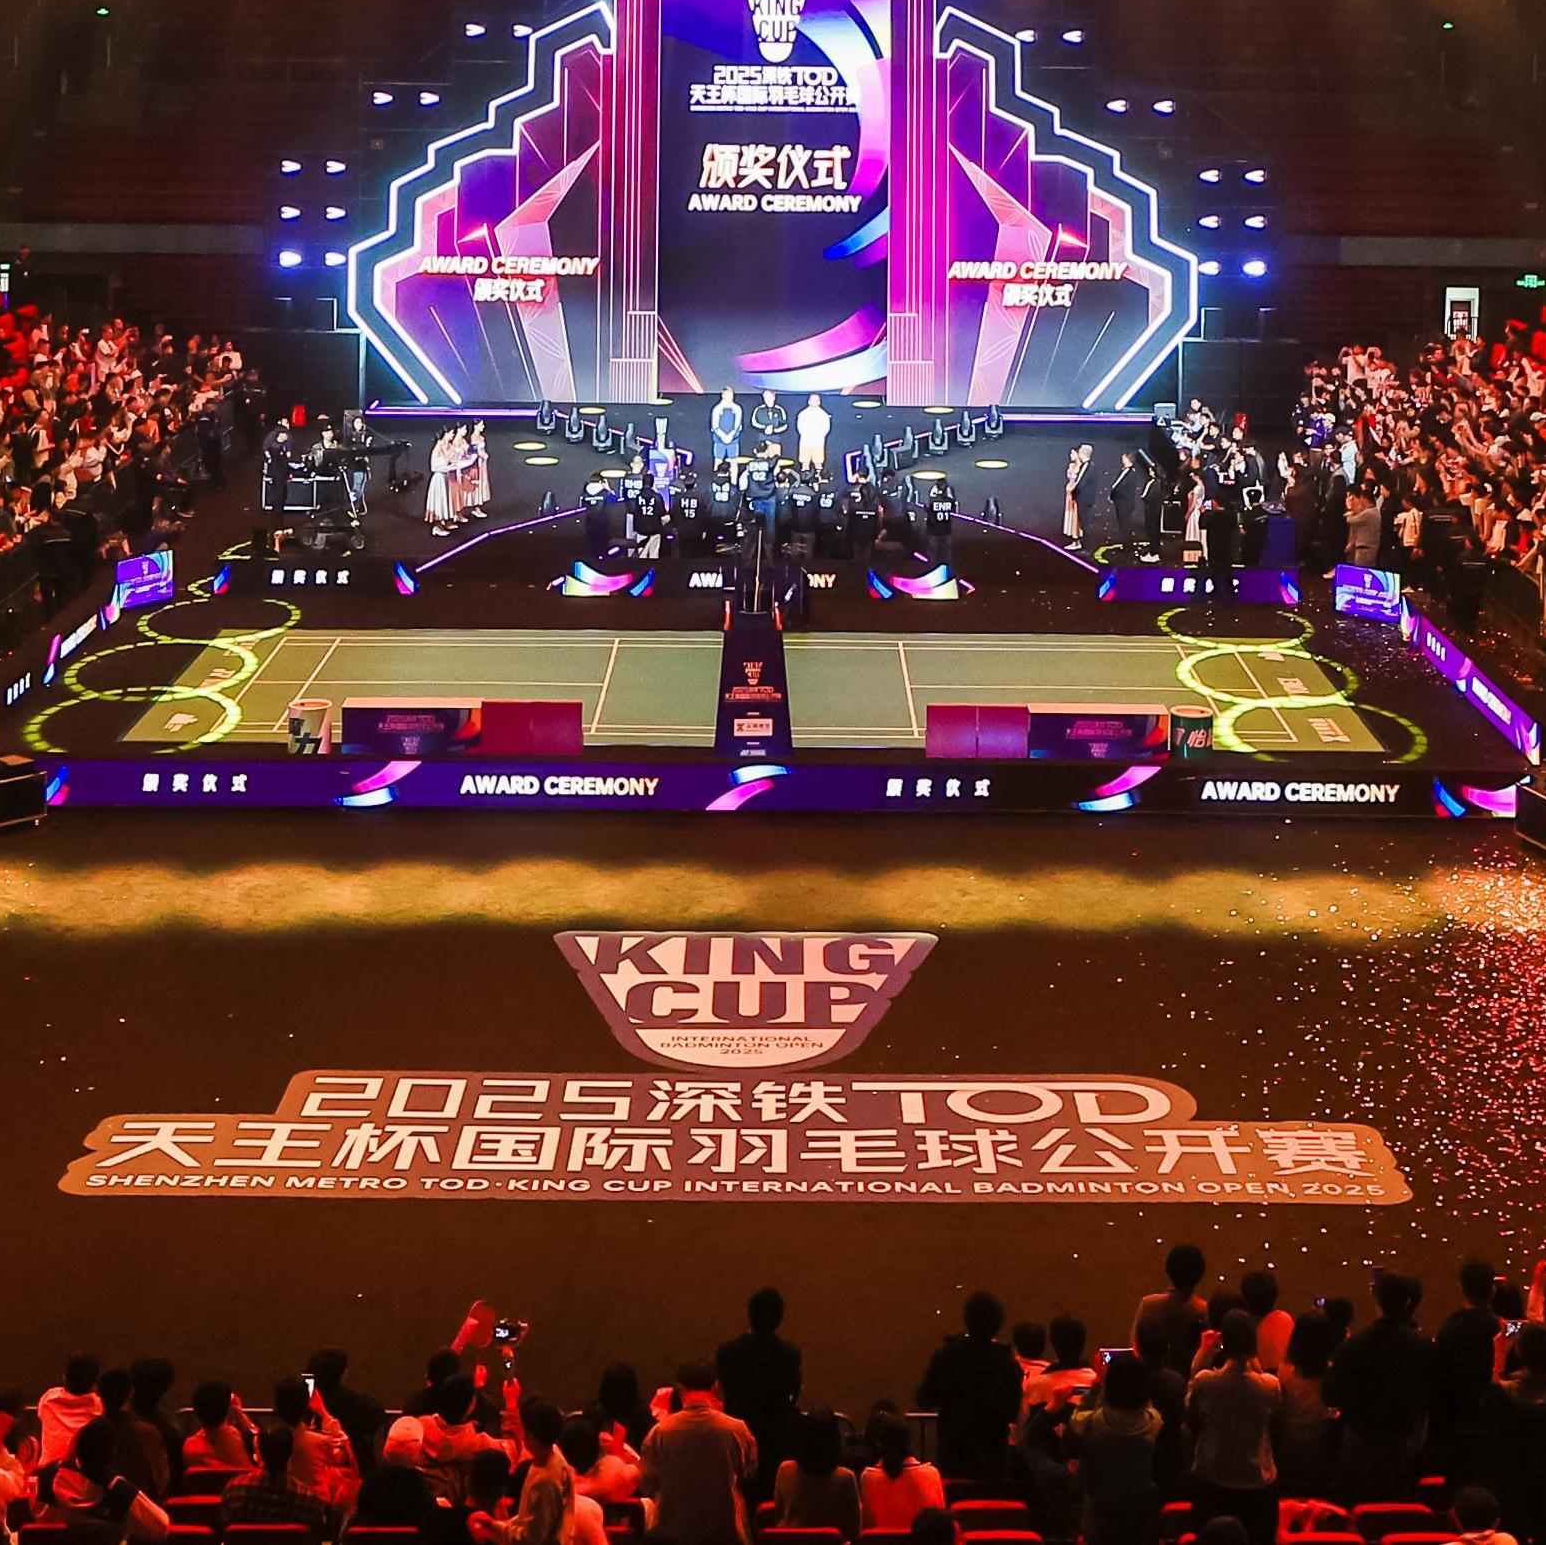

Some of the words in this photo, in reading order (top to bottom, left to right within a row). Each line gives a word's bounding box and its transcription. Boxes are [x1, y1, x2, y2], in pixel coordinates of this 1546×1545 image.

[754, 16, 800, 42] CUP
[699, 143, 852, 189] 颁奖仪式
[688, 193, 758, 212] AWARD
[760, 194, 862, 213] CEREMONY
[418, 255, 489, 274] AWARD
[491, 255, 601, 275] CEREMONY
[947, 261, 1018, 280] AWARD
[1019, 261, 1129, 280] CEREMONY
[641, 505, 655, 516] 12
[684, 508, 696, 518] 15
[933, 501, 952, 512] ENR
[936, 511, 950, 522] 01
[460, 774, 540, 795] AWARD
[543, 776, 659, 796] CEREMONY
[1201, 781, 1281, 802] AWARD
[1284, 782, 1401, 803] CEREMONY
[585, 934, 907, 977] KING
[622, 979, 888, 1024] CUP
[297, 1076, 1173, 1123] 2025深铁TOD
[96, 1122, 1371, 1176] 天王杯国际羽毛球公开赛
[85, 1173, 276, 1189] SHENZHEN
[285, 1175, 408, 1190] METRO
[602, 1179, 673, 1193] CUP
[683, 1179, 962, 1194] INTERNATIONAL
[973, 1181, 1191, 1195] BADMINTON
[1196, 1183, 1292, 1196] OPEN
[1301, 1183, 1386, 1197] 2025
